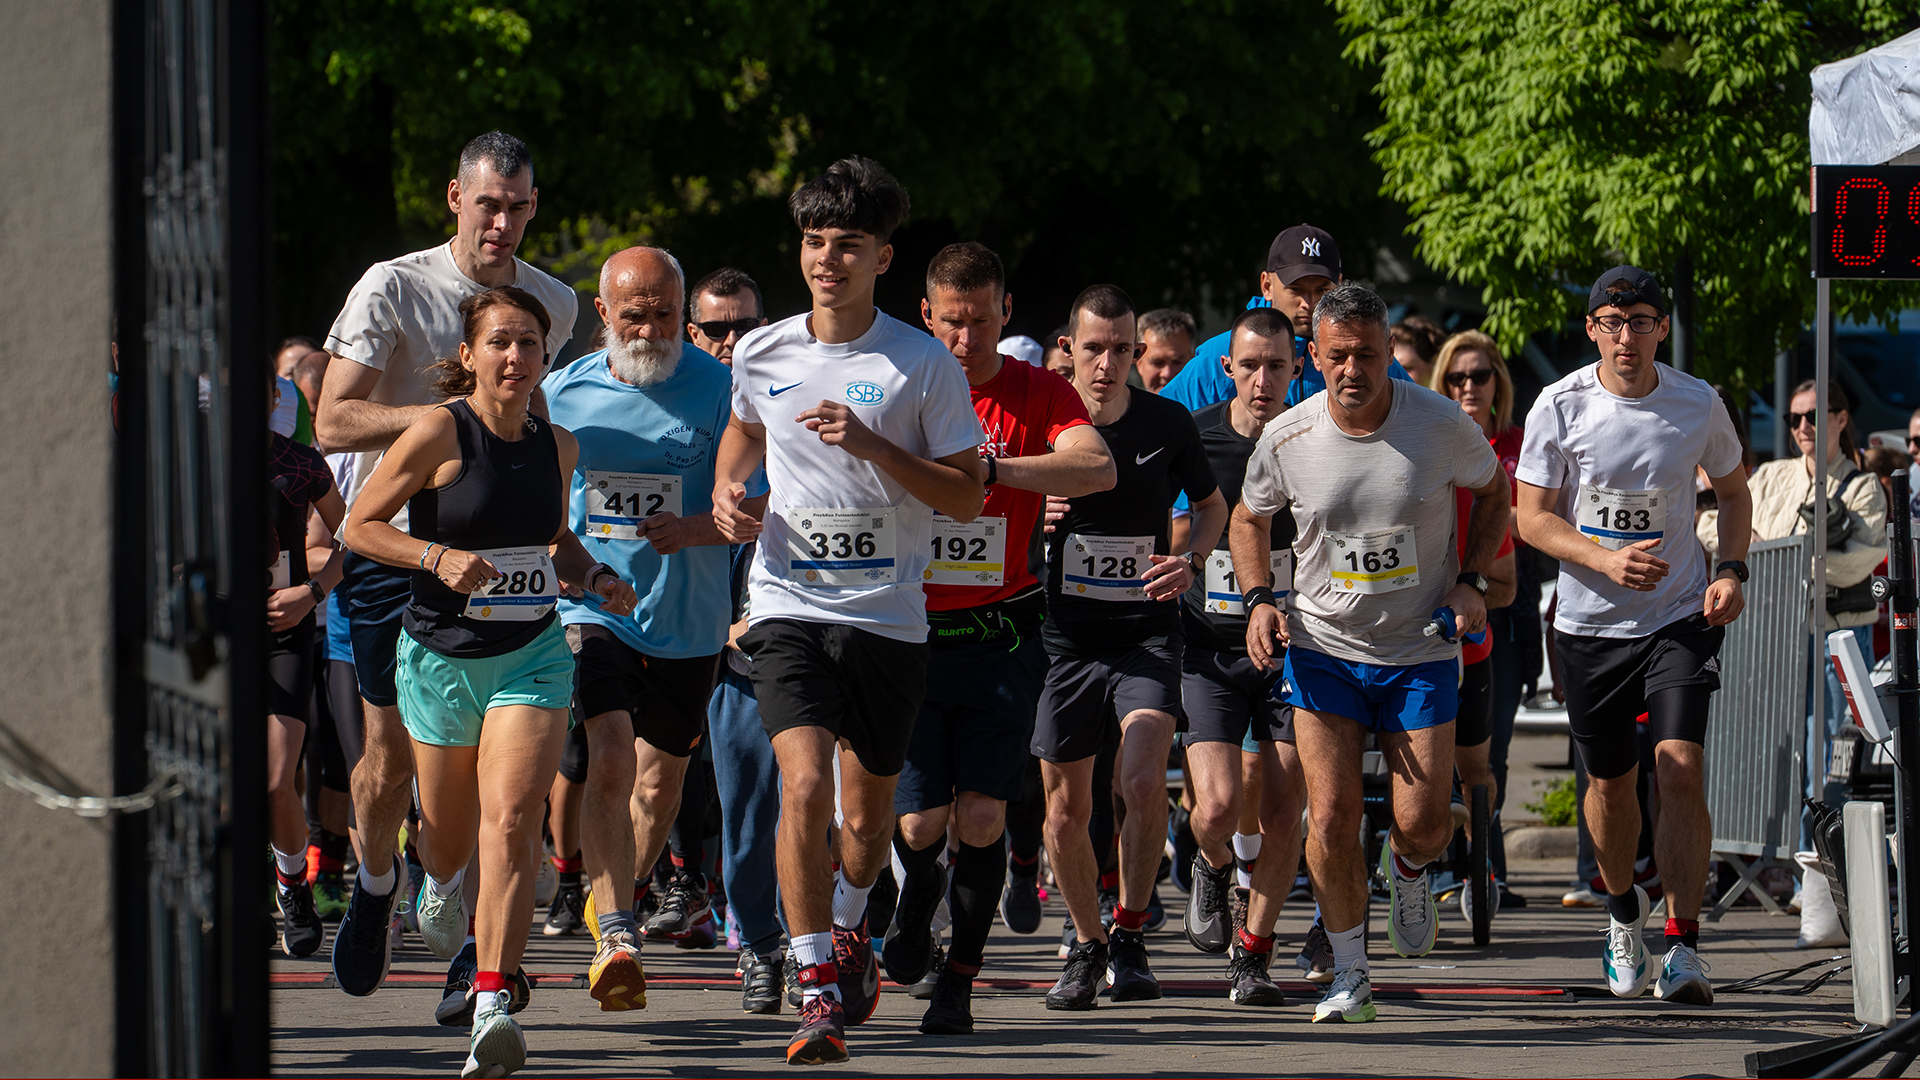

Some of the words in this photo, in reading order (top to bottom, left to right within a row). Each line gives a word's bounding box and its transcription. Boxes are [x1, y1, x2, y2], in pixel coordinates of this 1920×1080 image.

[1832, 178, 1920, 266] 0
[1301, 236, 1321, 257] NY
[660, 425, 692, 441] OXIGÉN
[604, 492, 664, 516] 412
[1597, 506, 1650, 531] 183
[809, 532, 876, 558] 336
[931, 536, 987, 561] 192
[1082, 556, 1137, 578] 128
[1345, 547, 1400, 573] 163
[487, 569, 546, 595] 280
[938, 627, 974, 636] RUNTO
